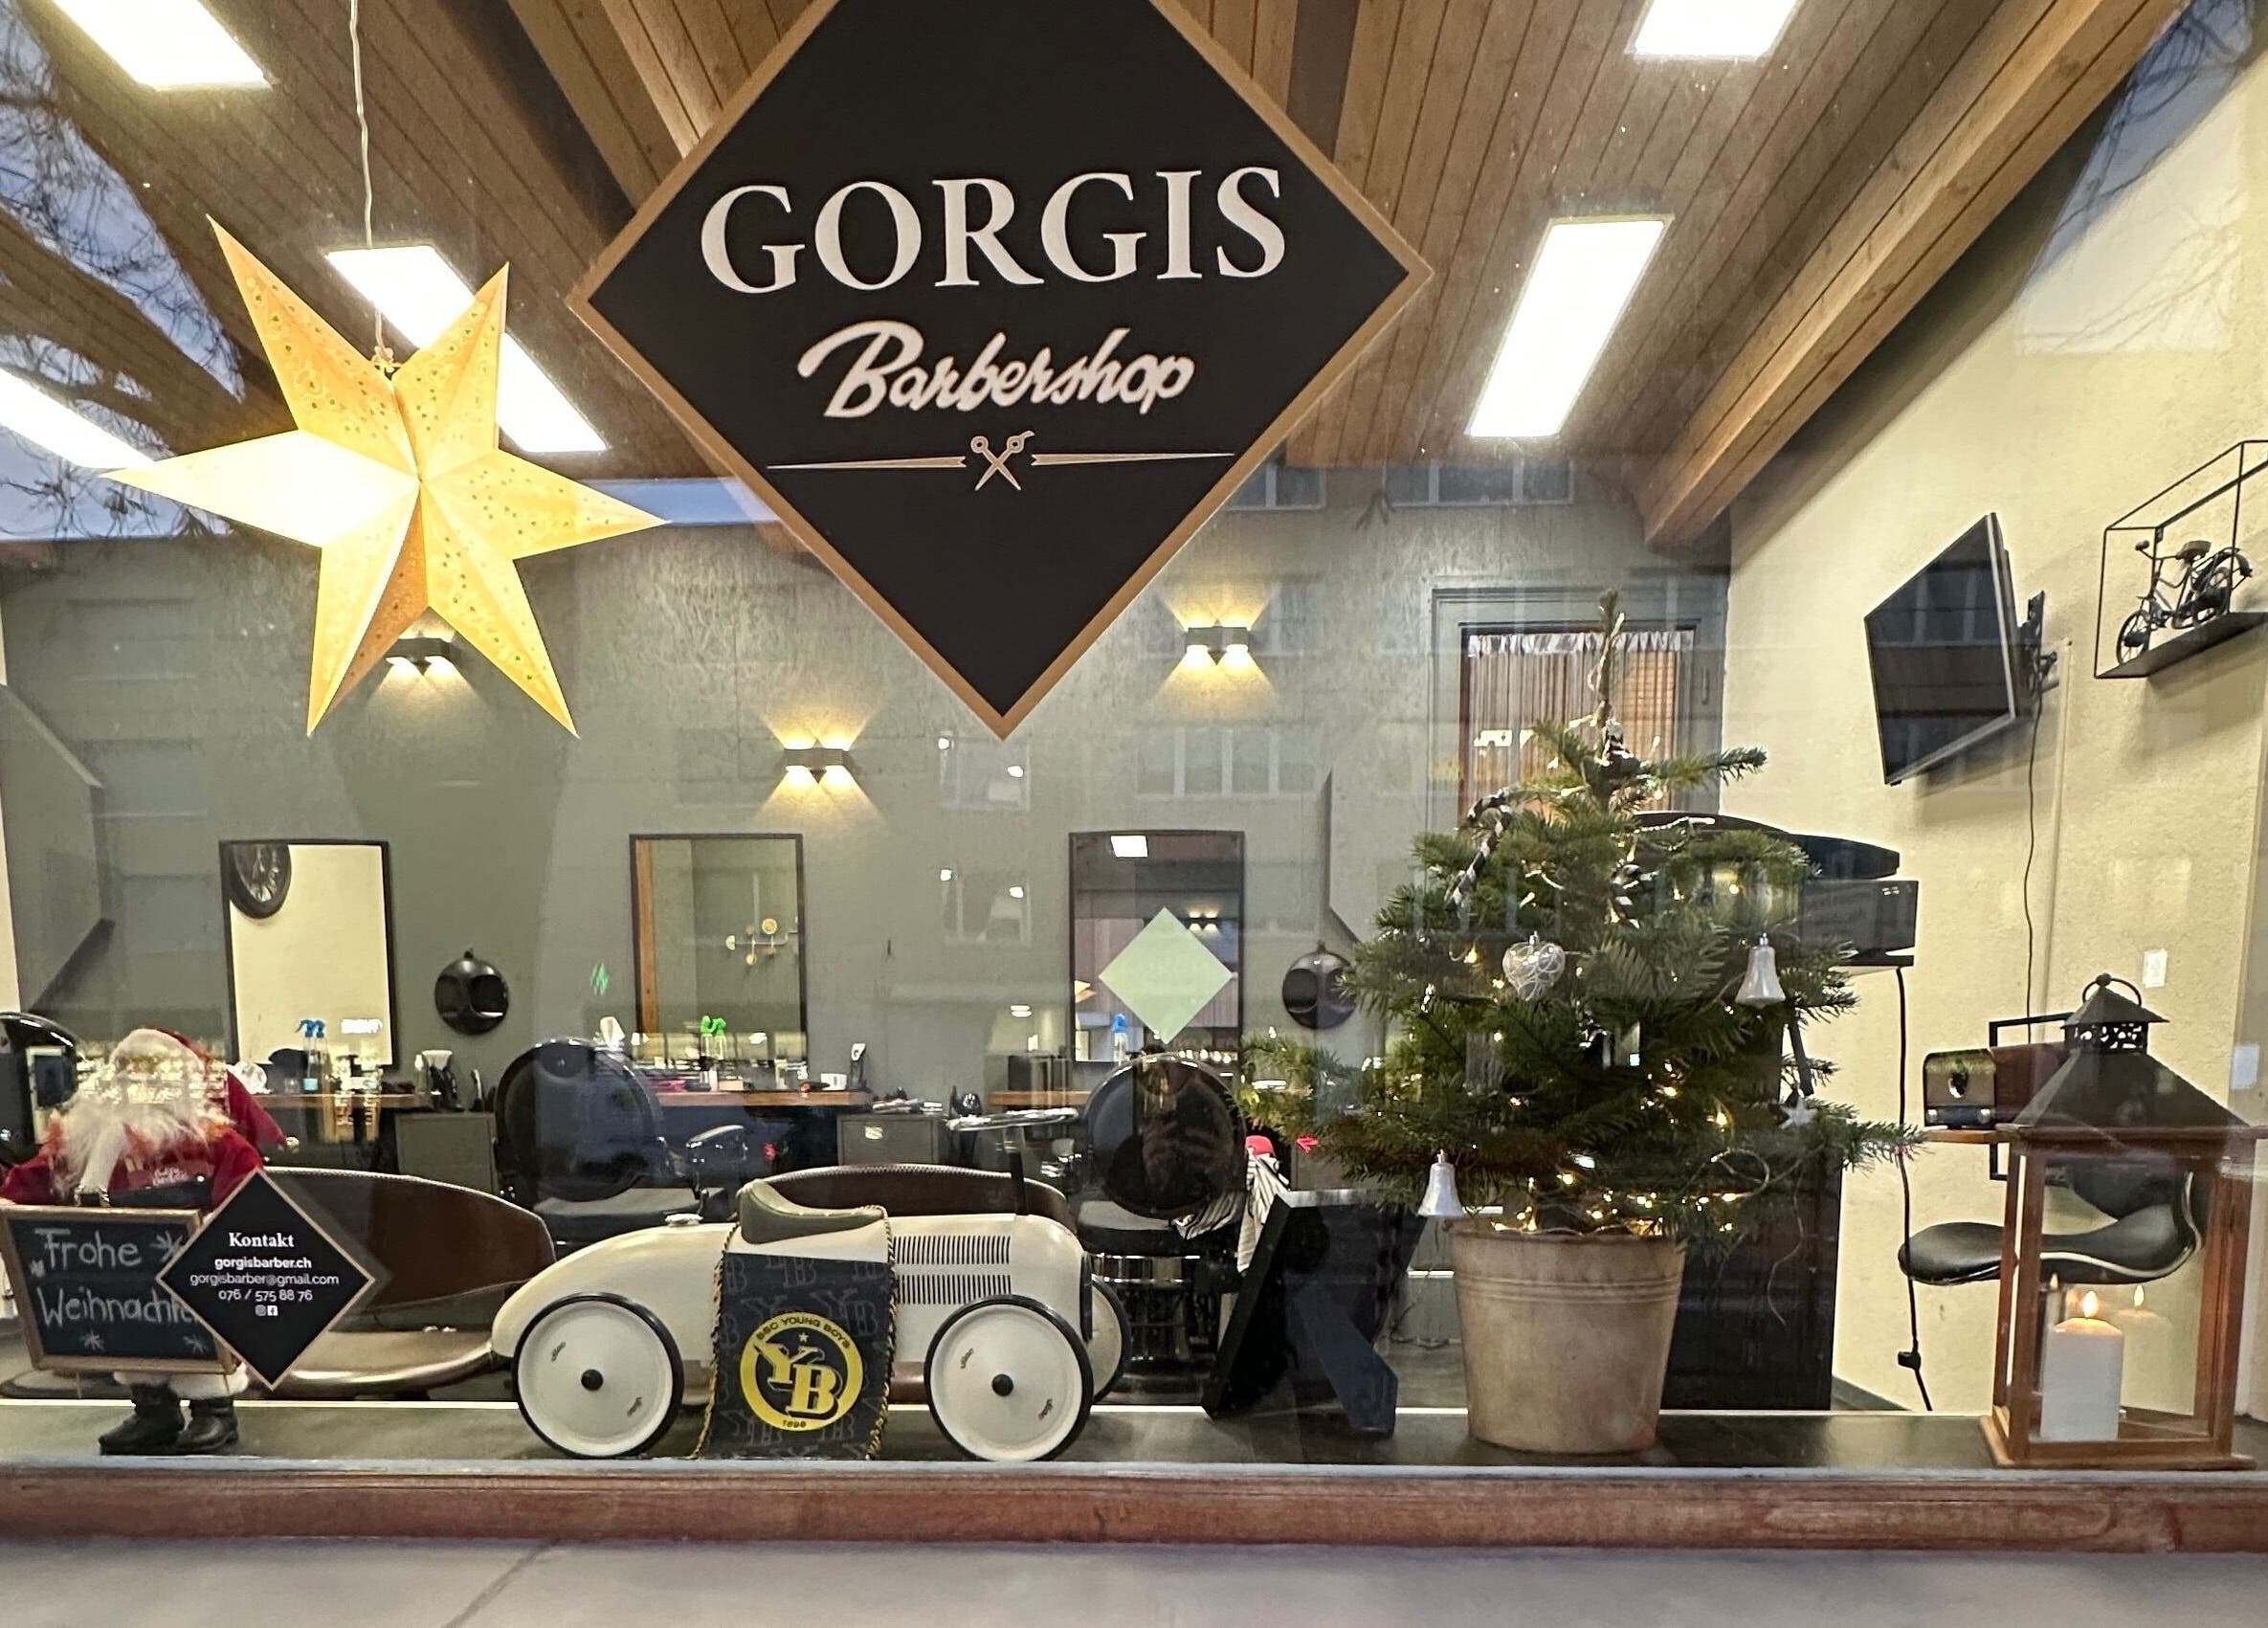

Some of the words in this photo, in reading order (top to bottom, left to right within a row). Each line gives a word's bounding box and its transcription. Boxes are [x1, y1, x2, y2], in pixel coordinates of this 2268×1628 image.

[700, 167, 1286, 295] GORGIS
[797, 320, 1195, 419] Barbershop
[34, 1228, 143, 1268] Frohe
[229, 1233, 295, 1248] Kontakt
[214, 1256, 312, 1271] gorgisbarber.ch
[189, 1273, 340, 1287] gorgisbarber@gmail.com
[218, 1289, 241, 1302] 076
[255, 1290, 277, 1303] 575
[278, 1289, 295, 1302] 88
[298, 1290, 313, 1302] 76
[780, 1316, 821, 1327] YOUNG
[823, 1323, 851, 1349] BOYS
